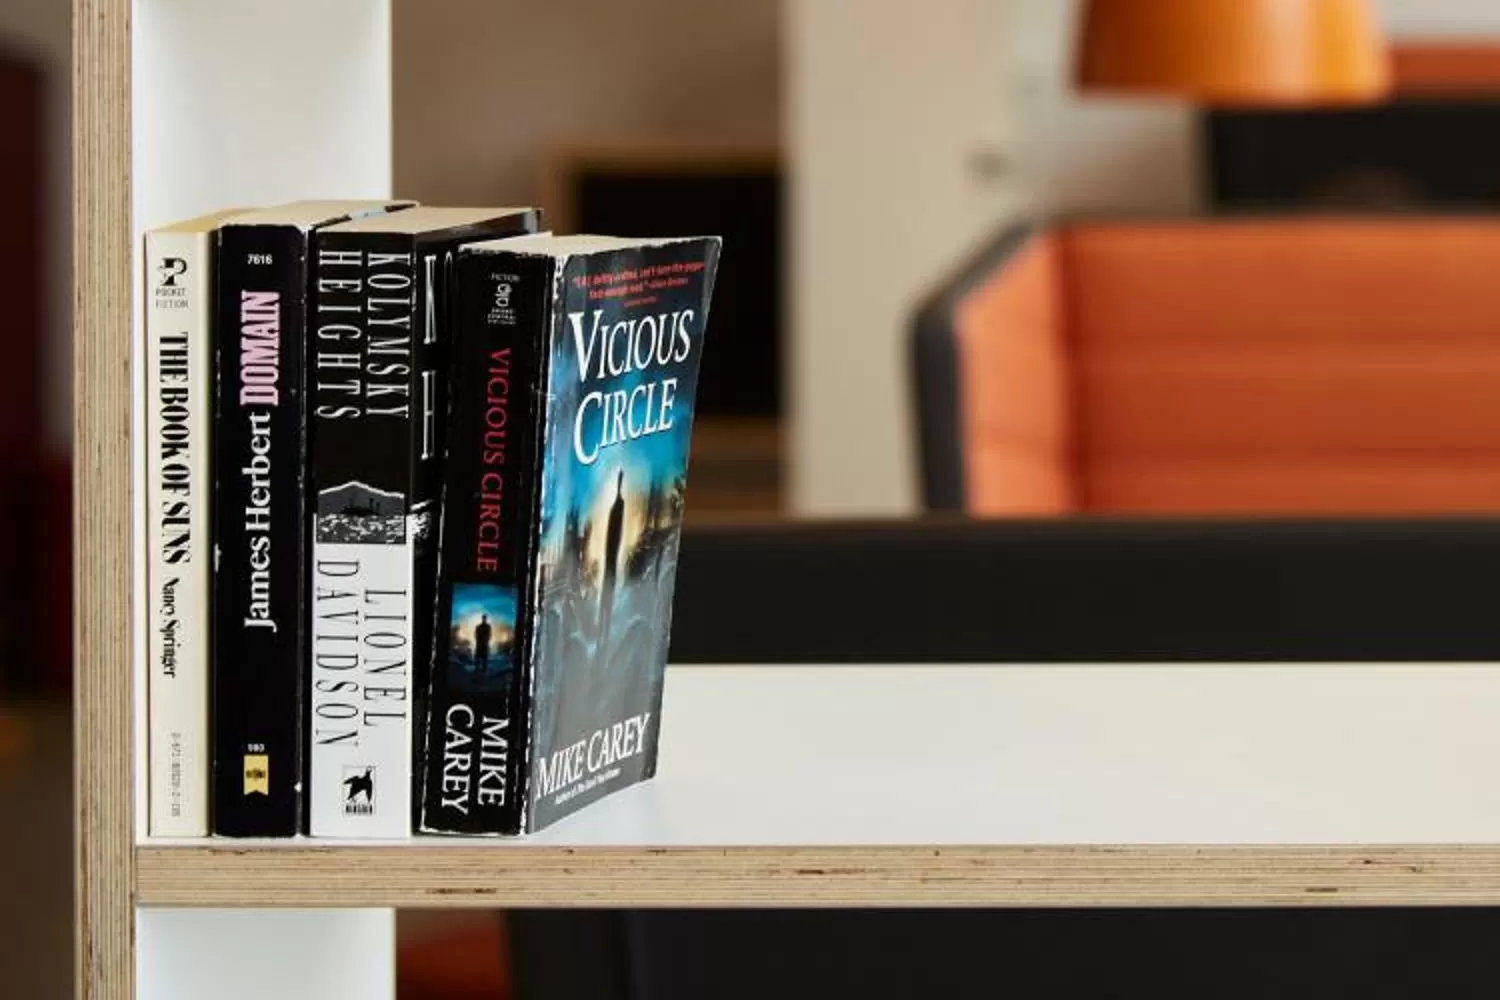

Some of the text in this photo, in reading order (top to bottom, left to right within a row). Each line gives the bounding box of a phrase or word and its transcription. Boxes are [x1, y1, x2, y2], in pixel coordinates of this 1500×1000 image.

[317, 250, 363, 419] HEIGHTS
[366, 253, 411, 418] KOLYMSKY
[568, 309, 695, 383] VICIOUS
[160, 332, 191, 564] THE BOOK OF SUNS
[239, 290, 281, 632] James Herbert DOMAIN
[483, 348, 512, 464] VICIOUS
[574, 378, 678, 464] CIRCLE
[477, 472, 504, 573] CIRCLE
[316, 561, 359, 747] DAVIDSON
[364, 589, 407, 726] LIONEL
[442, 704, 475, 815] CAREY
[477, 716, 510, 807] MIKE
[535, 740, 587, 800] MIKE
[587, 712, 651, 772] CAREY
